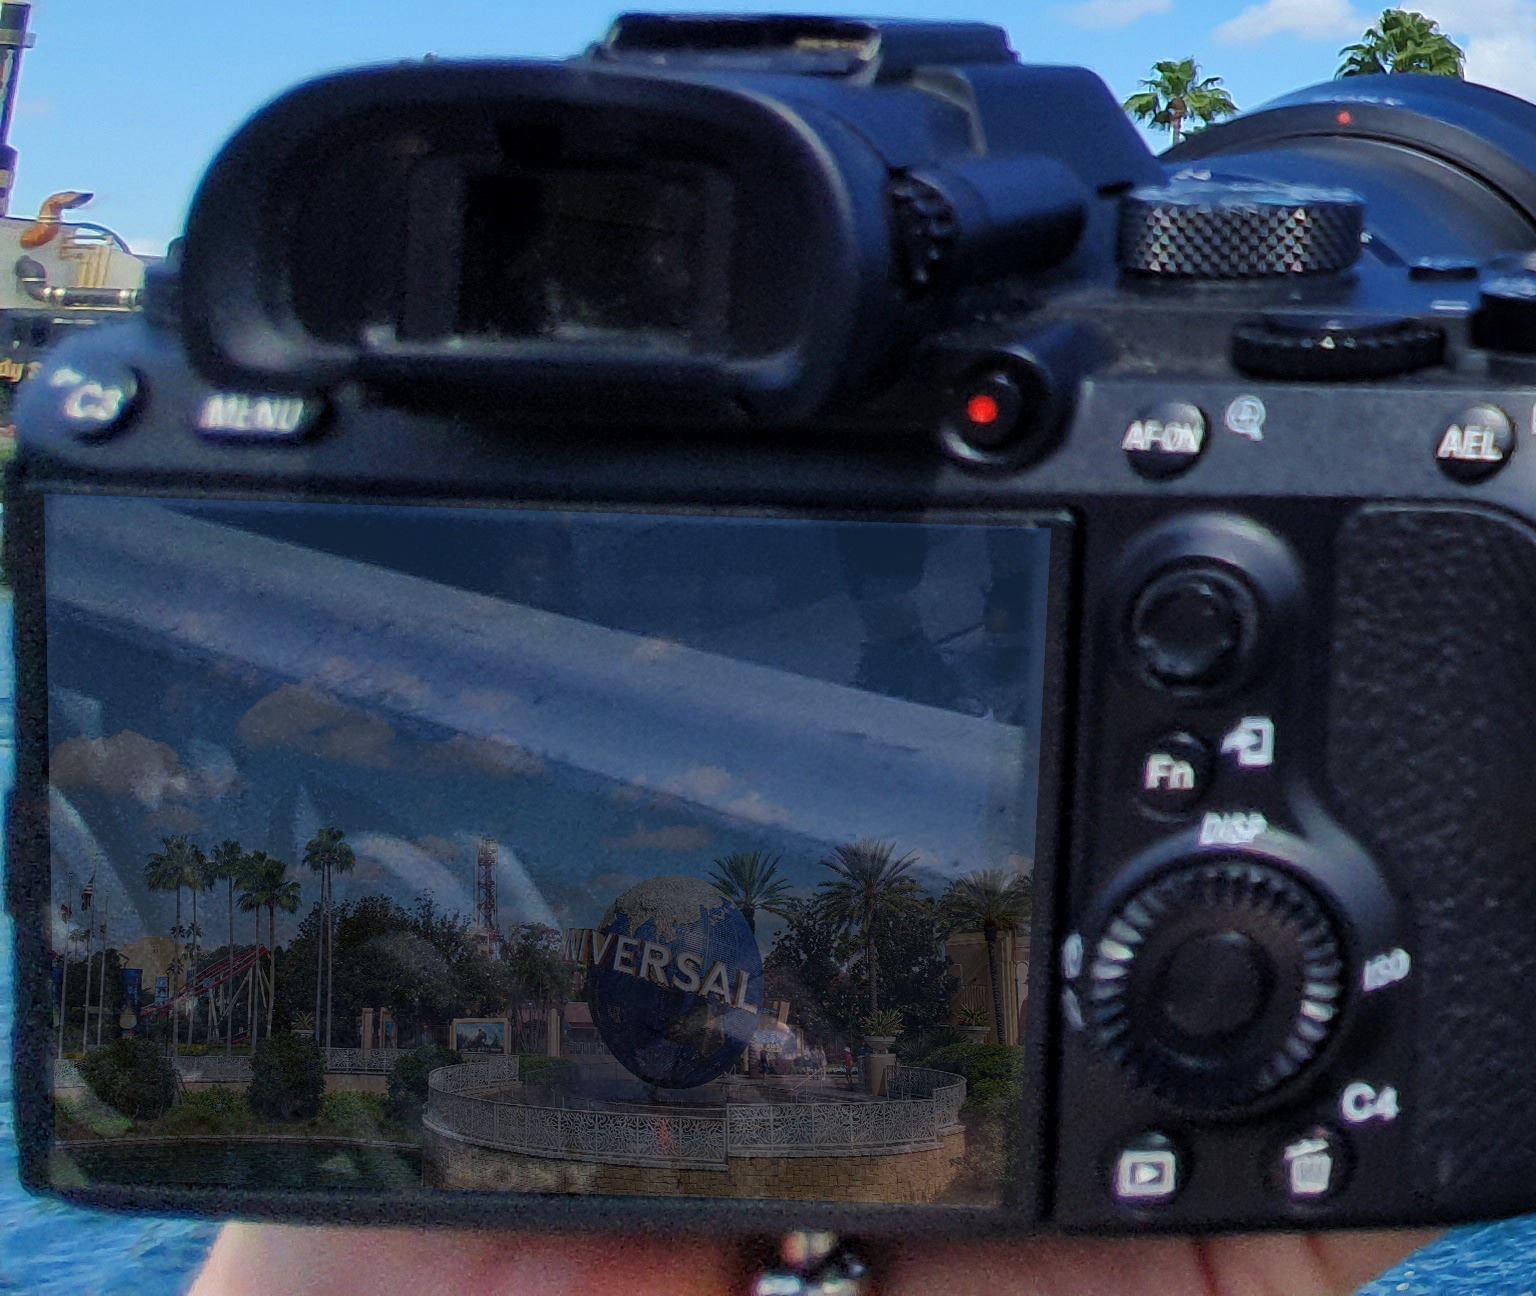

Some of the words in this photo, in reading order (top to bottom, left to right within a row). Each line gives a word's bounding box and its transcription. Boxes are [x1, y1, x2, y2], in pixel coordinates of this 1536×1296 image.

[200, 394, 304, 434] MENU
[1436, 422, 1503, 460] AEL
[1145, 753, 1195, 790] Fn
[1199, 811, 1268, 846] DISP
[1362, 947, 1412, 992] ISO
[1341, 1082, 1400, 1123] C4
